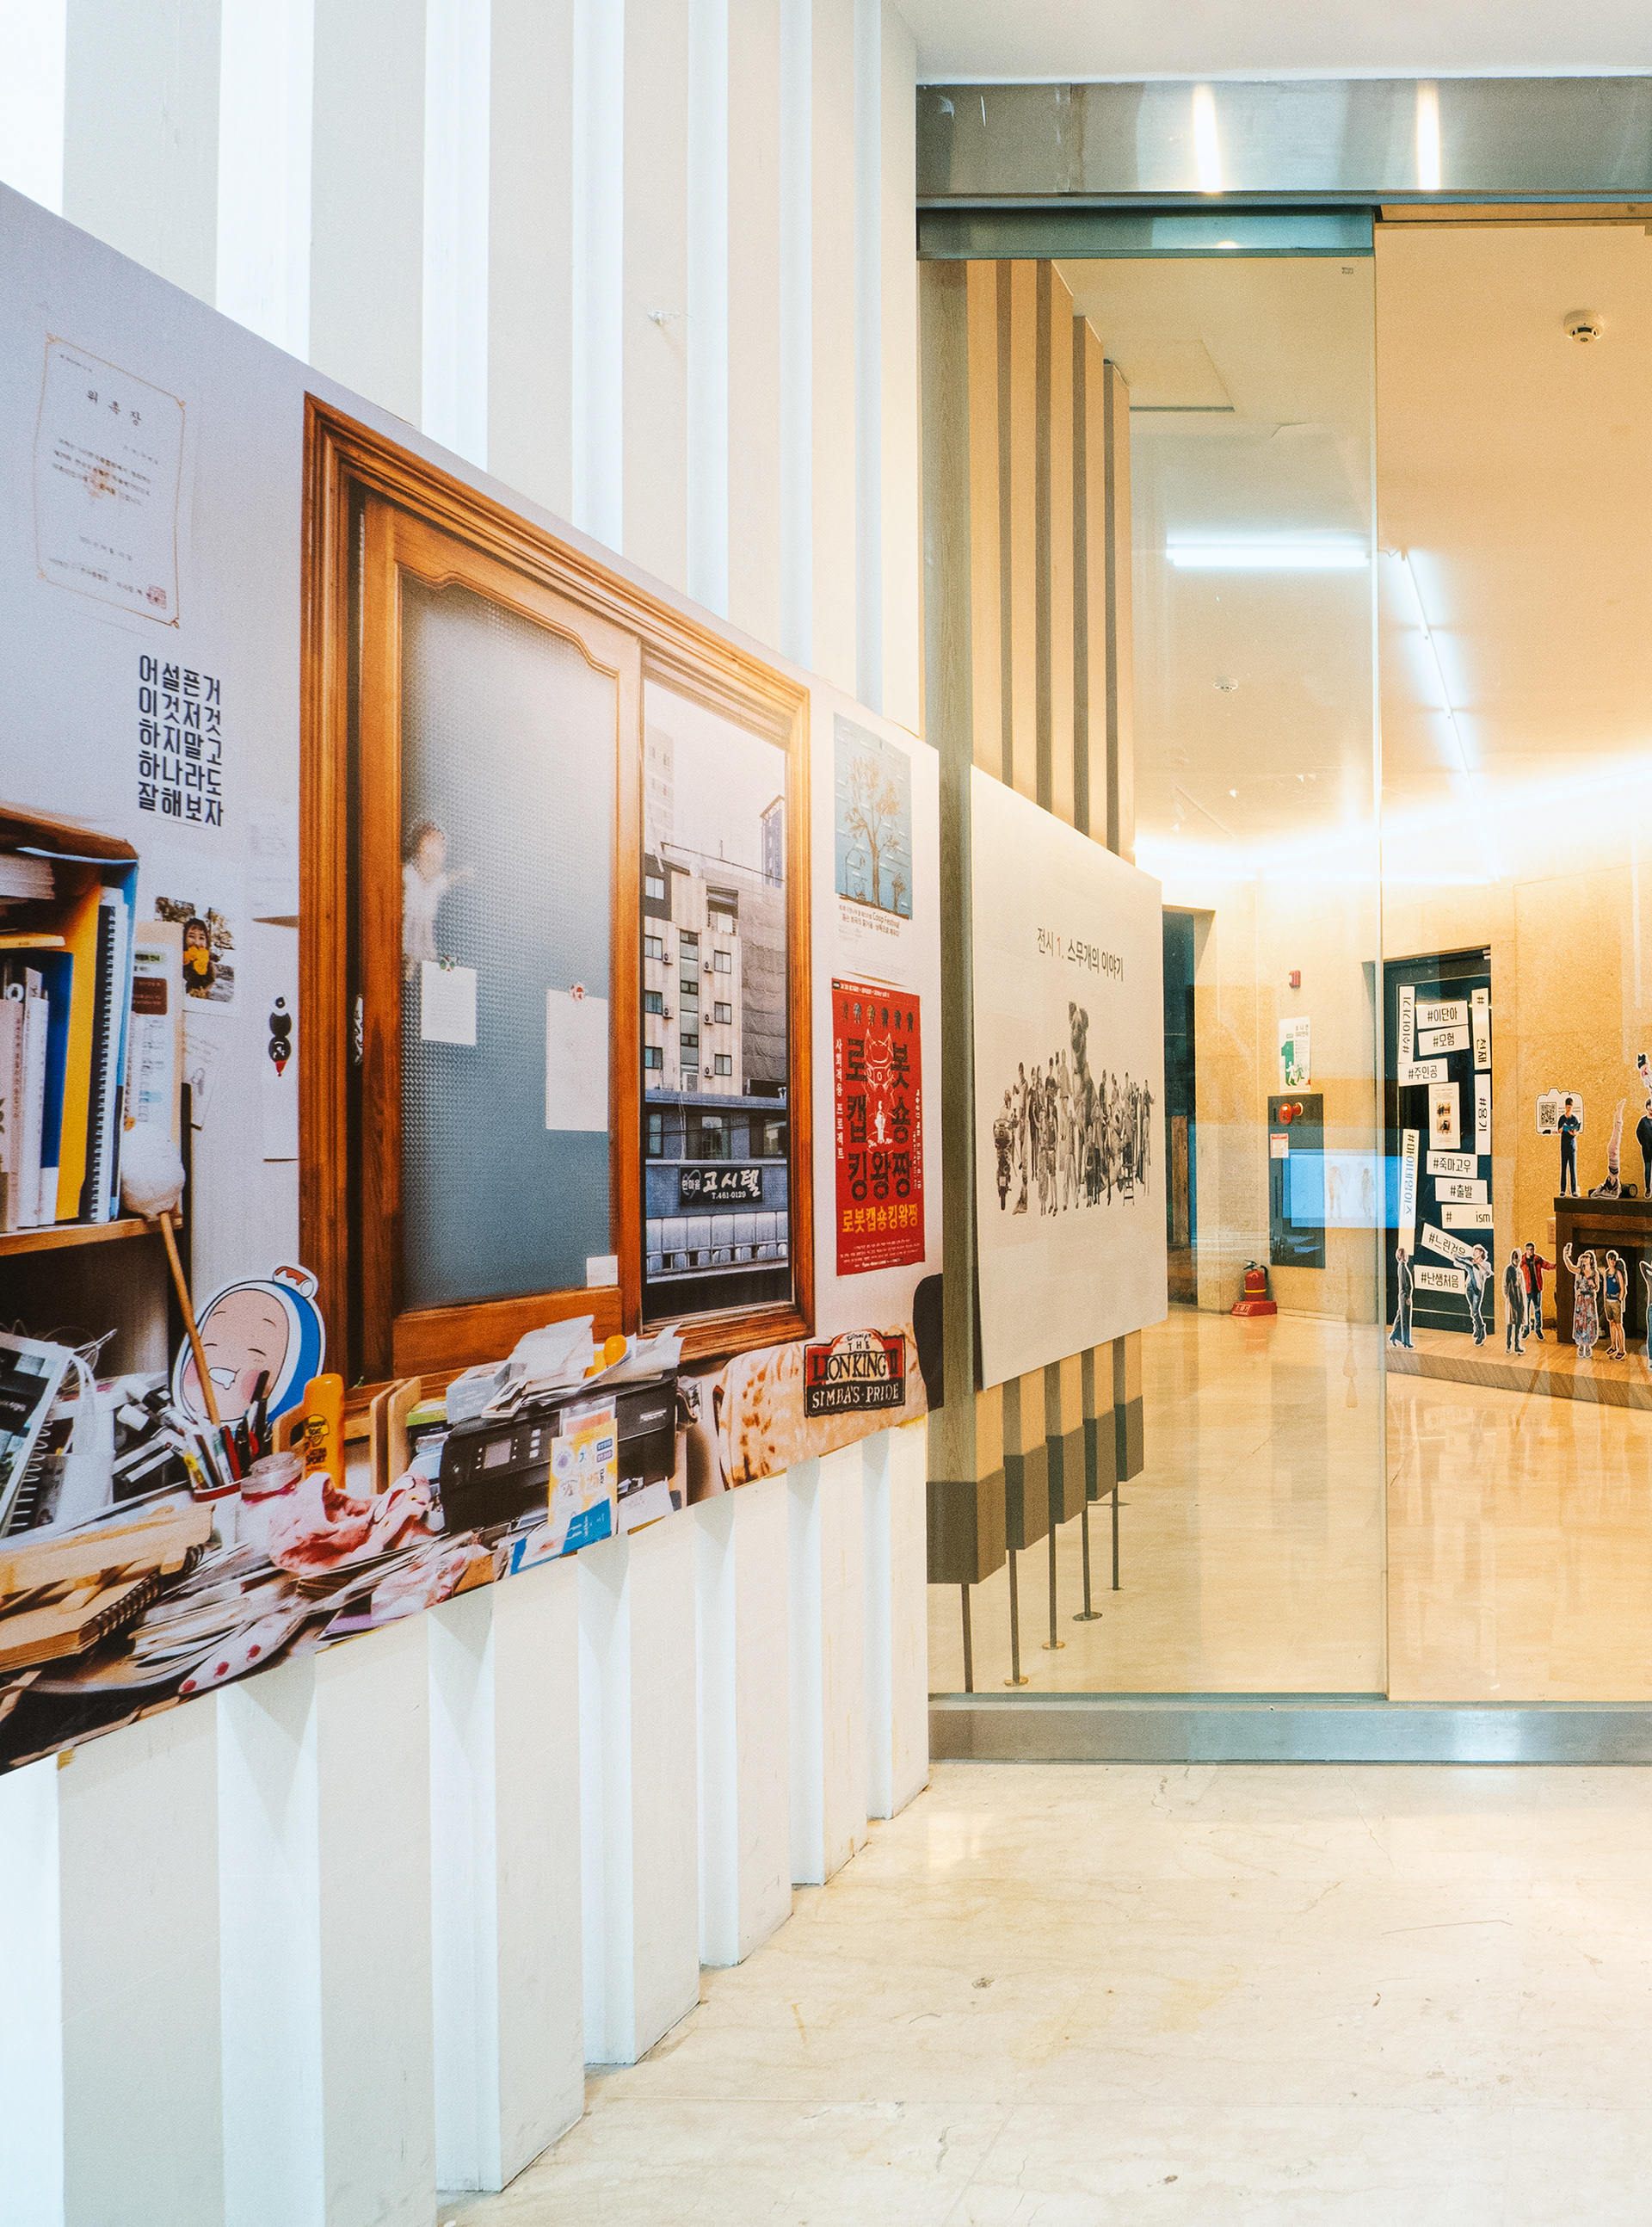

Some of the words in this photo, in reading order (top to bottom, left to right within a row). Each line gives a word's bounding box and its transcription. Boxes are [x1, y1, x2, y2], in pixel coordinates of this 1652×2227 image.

[139, 654, 220, 706] 어설픈거
[138, 687, 221, 737] 이것저것
[139, 718, 222, 766] 하지말고
[138, 750, 222, 796] 하나라도
[138, 781, 224, 827] 잘해보자
[1037, 928, 1053, 957] 전시
[1067, 939, 1100, 974] 스무개의
[1101, 951, 1124, 982] 이야기
[1427, 1007, 1458, 1021] #이단아
[1433, 1033, 1455, 1047] #모험
[1408, 1064, 1438, 1080] #주인공
[848, 1151, 913, 1201] 킹왕짱
[1433, 1157, 1471, 1173] #죽마고우
[703, 1169, 761, 1197] 고시텔
[1450, 1184, 1472, 1199] #출발
[842, 1203, 918, 1233] 로봇캡숑킹왕짱
[1476, 1211, 1491, 1223] ism
[1421, 1272, 1459, 1288] #난생처음
[848, 1341, 870, 1351] THE
[812, 1354, 851, 1381] LION
[852, 1351, 886, 1379] KING
[865, 1383, 899, 1403] PRIDE
